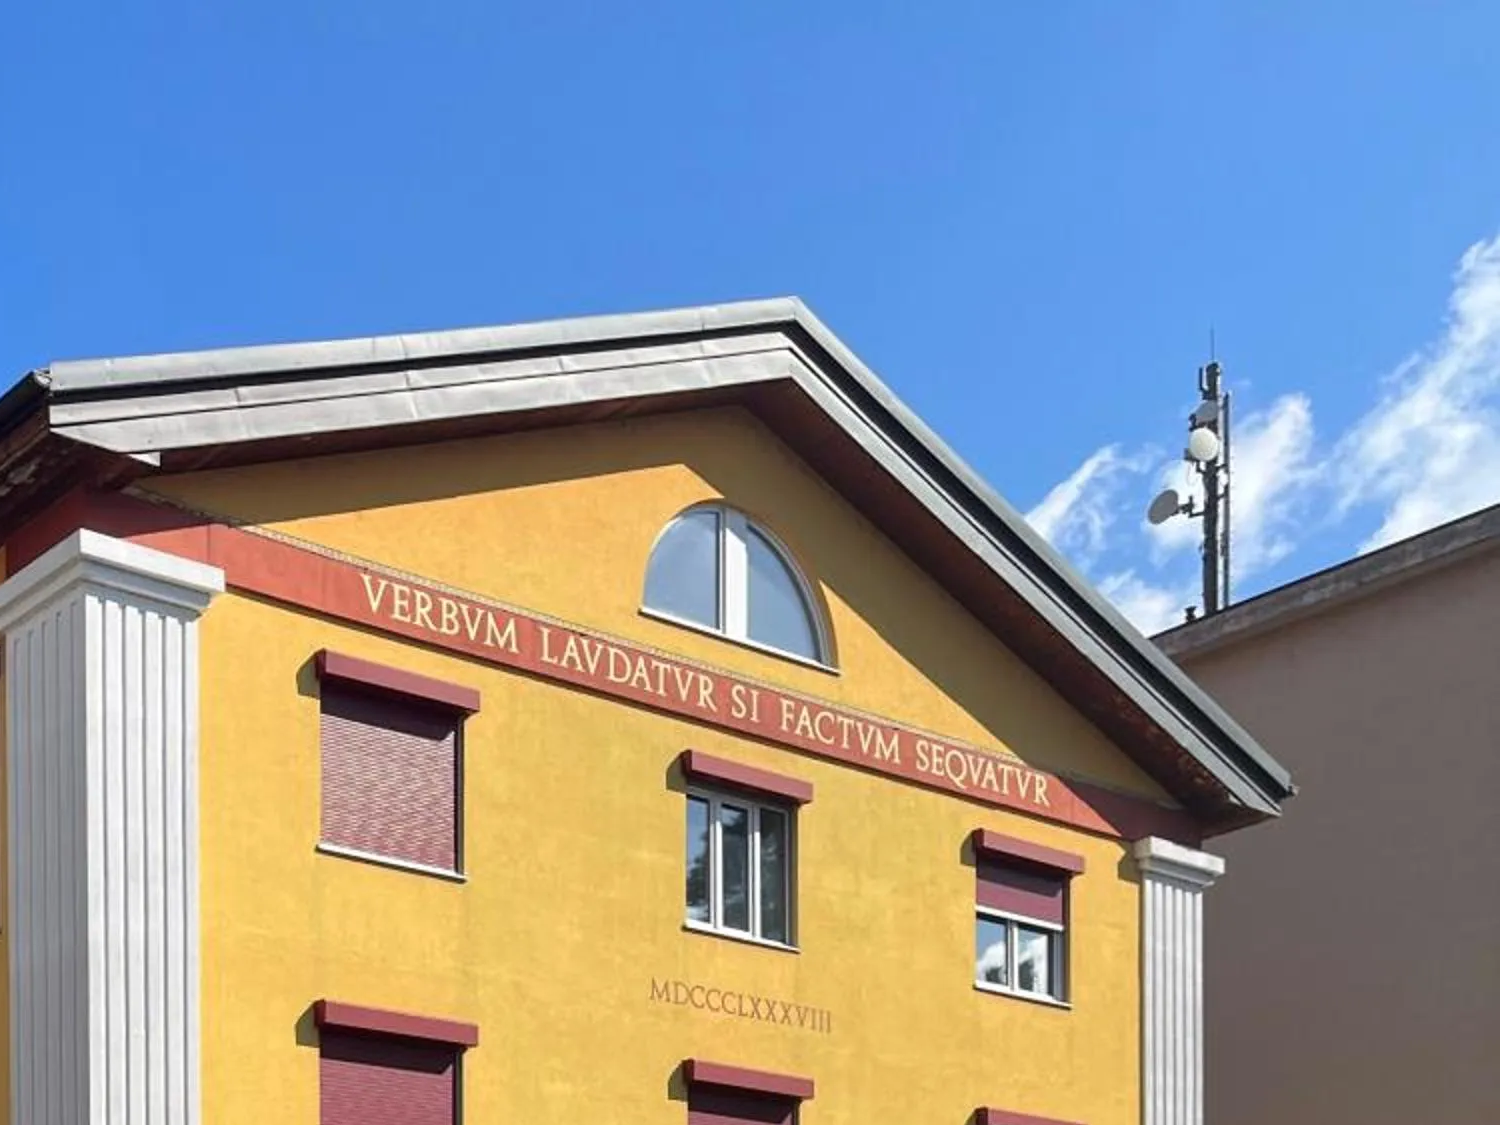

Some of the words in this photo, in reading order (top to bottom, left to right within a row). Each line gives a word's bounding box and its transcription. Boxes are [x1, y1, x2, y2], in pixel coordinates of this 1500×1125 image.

[360, 573, 519, 654] VERBVM
[540, 627, 717, 712] LAVDATVR
[731, 685, 760, 723] SI
[780, 700, 900, 765] FACTVM
[915, 739, 1049, 806] SEQVATVR
[649, 976, 832, 1034] MDCCCLXXXVIII
